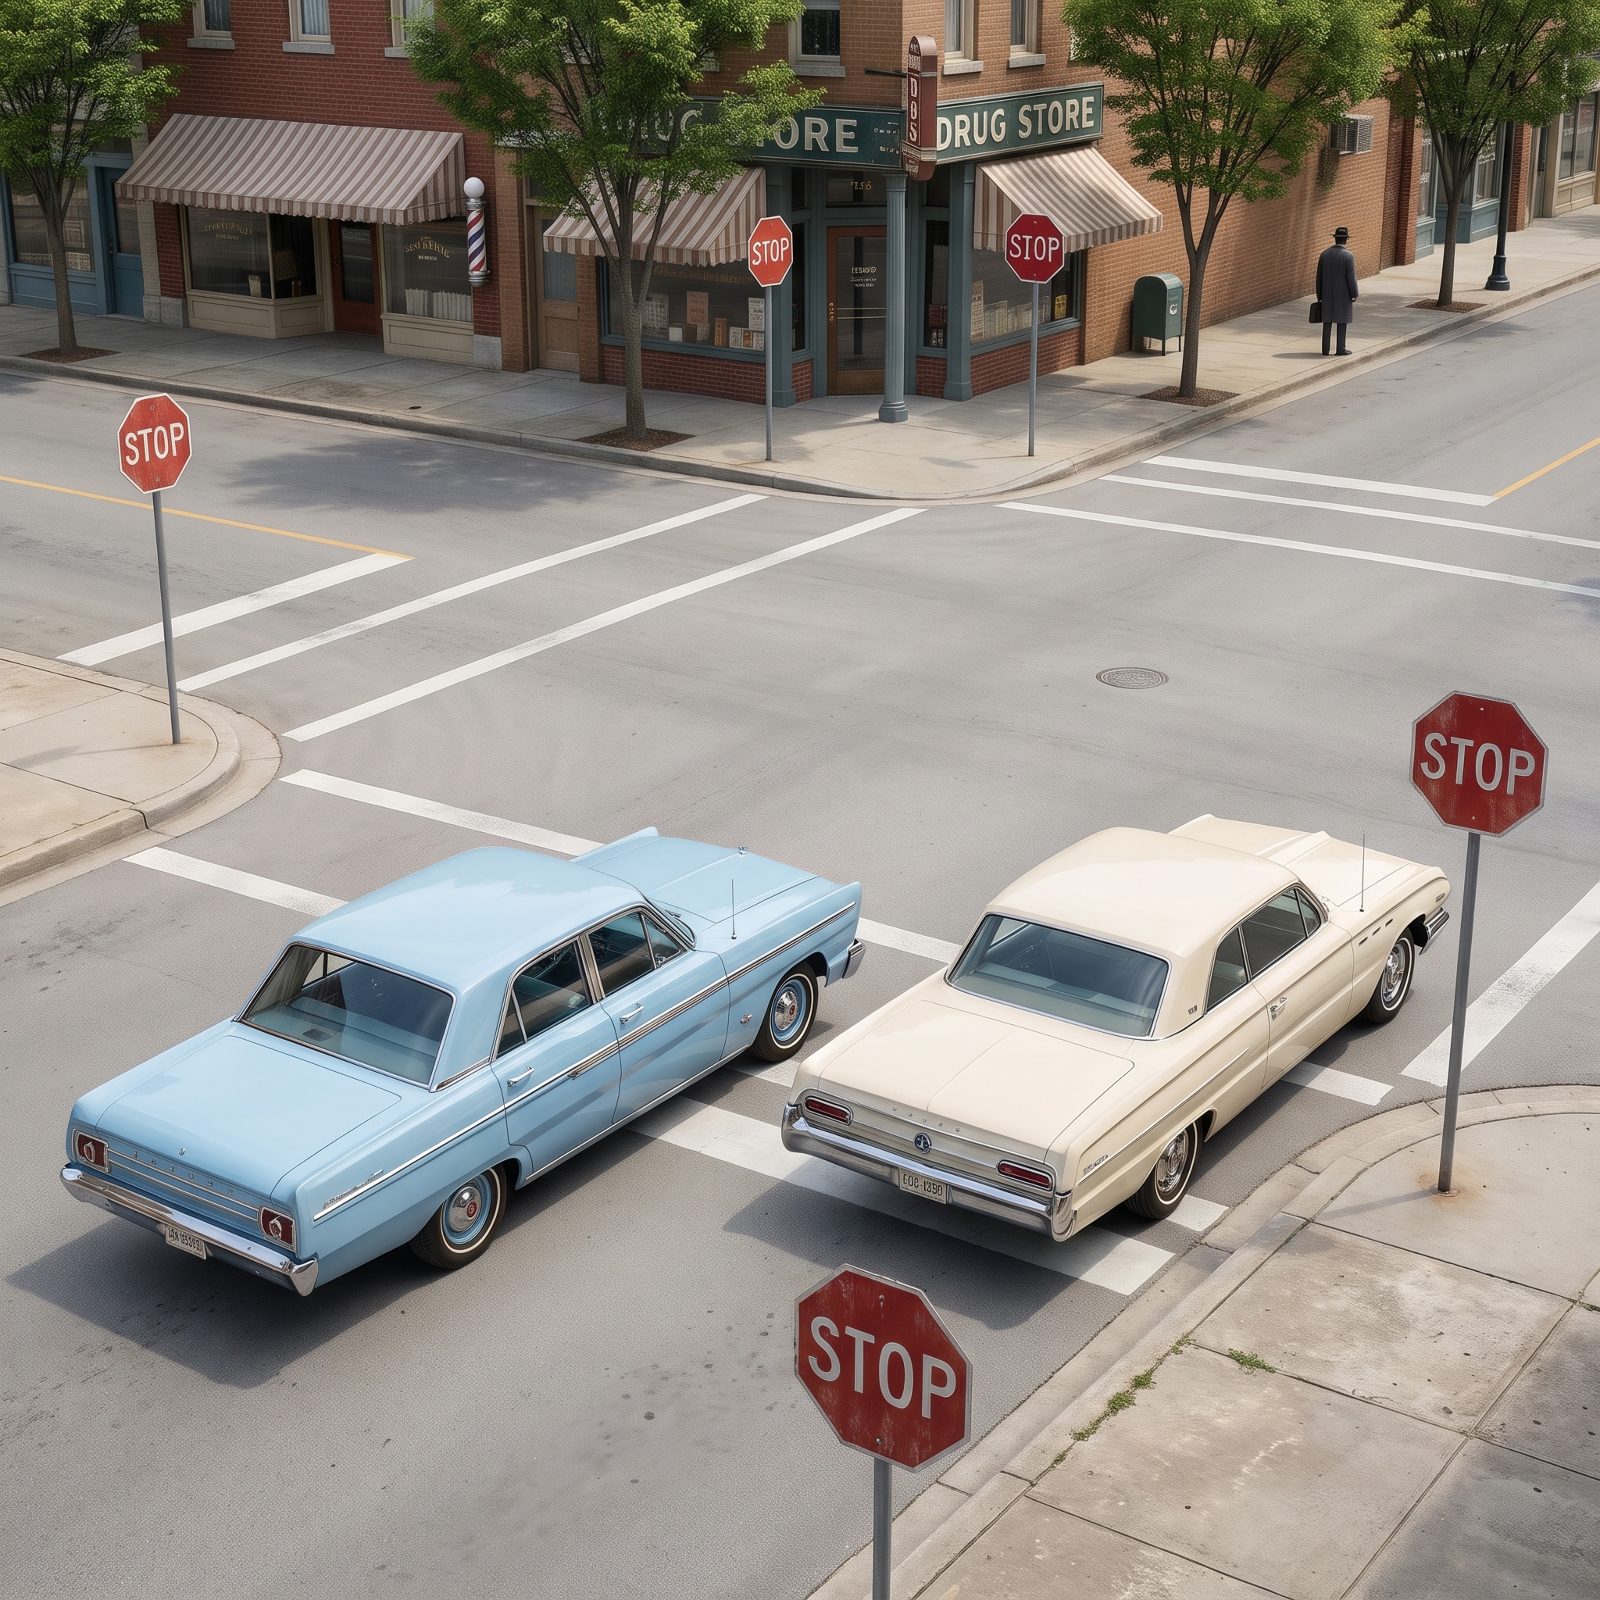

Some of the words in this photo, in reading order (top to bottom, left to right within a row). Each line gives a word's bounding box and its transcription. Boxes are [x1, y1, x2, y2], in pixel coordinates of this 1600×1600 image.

[726, 114, 859, 153] ORE
[937, 108, 1006, 151] DRUG
[1018, 96, 1095, 139] STORE
[752, 237, 790, 266] STOP
[1009, 233, 1060, 263] STOP
[125, 422, 185, 466] STOP
[1420, 732, 1536, 795] STOP
[808, 1316, 957, 1420] STOP
